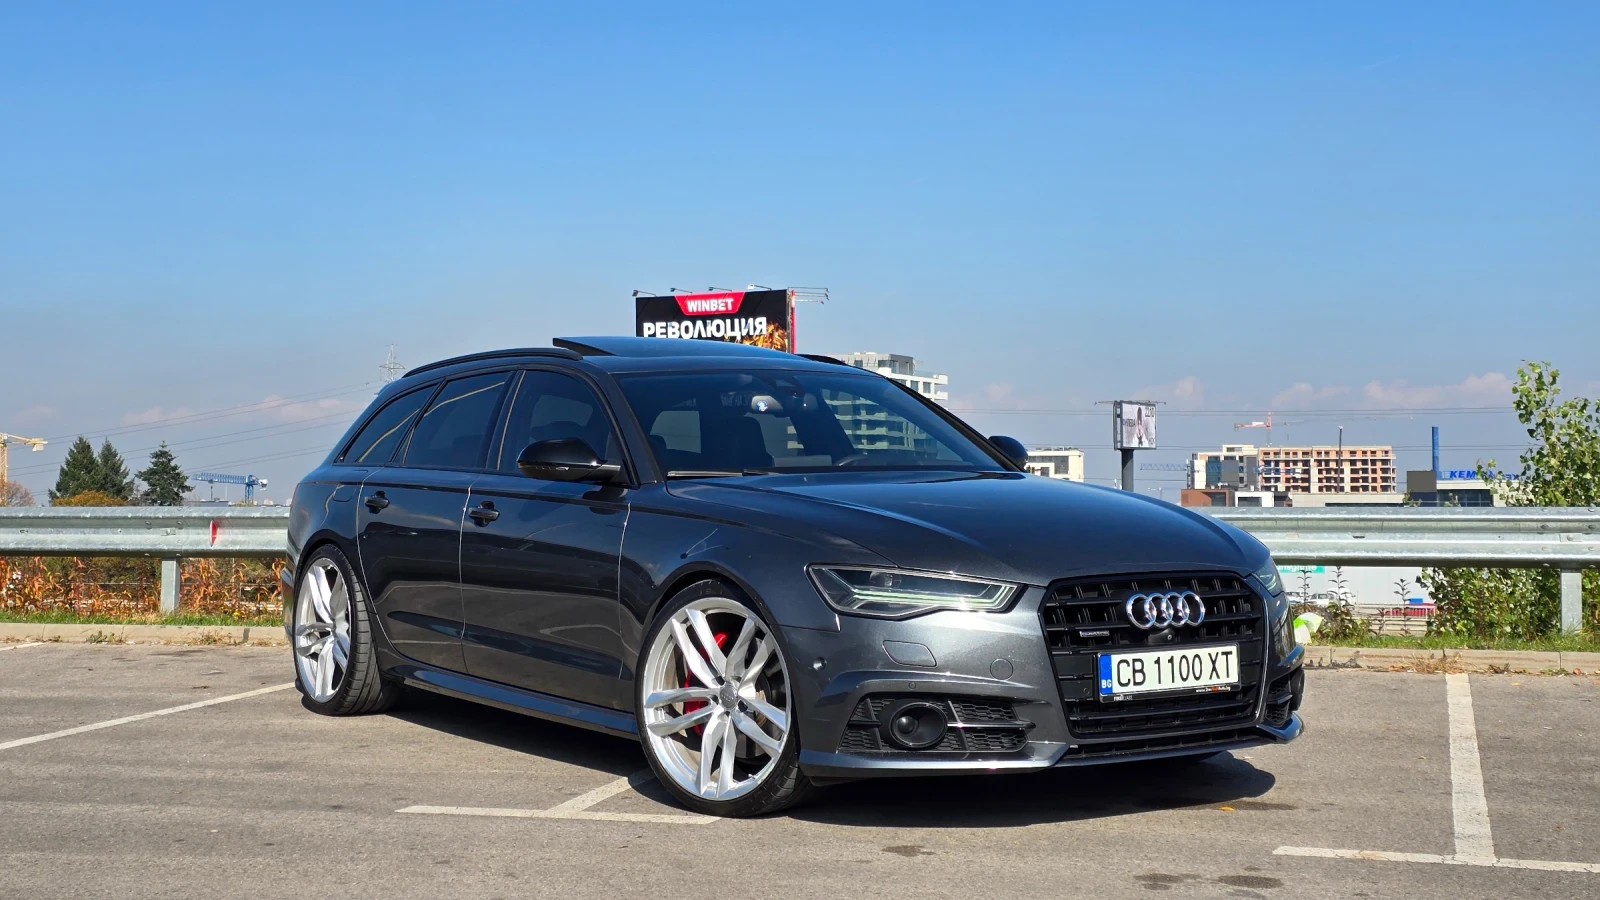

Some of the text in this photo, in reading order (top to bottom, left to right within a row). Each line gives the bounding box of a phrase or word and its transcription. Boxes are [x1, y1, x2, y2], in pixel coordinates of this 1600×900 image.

[687, 298, 734, 313] WINBET
[643, 317, 767, 340] РЕВОЛЮЦИЯ
[1450, 470, 1479, 479] KEM
[1117, 651, 1233, 688] CB 1100 XT
[1101, 680, 1113, 689] BG
